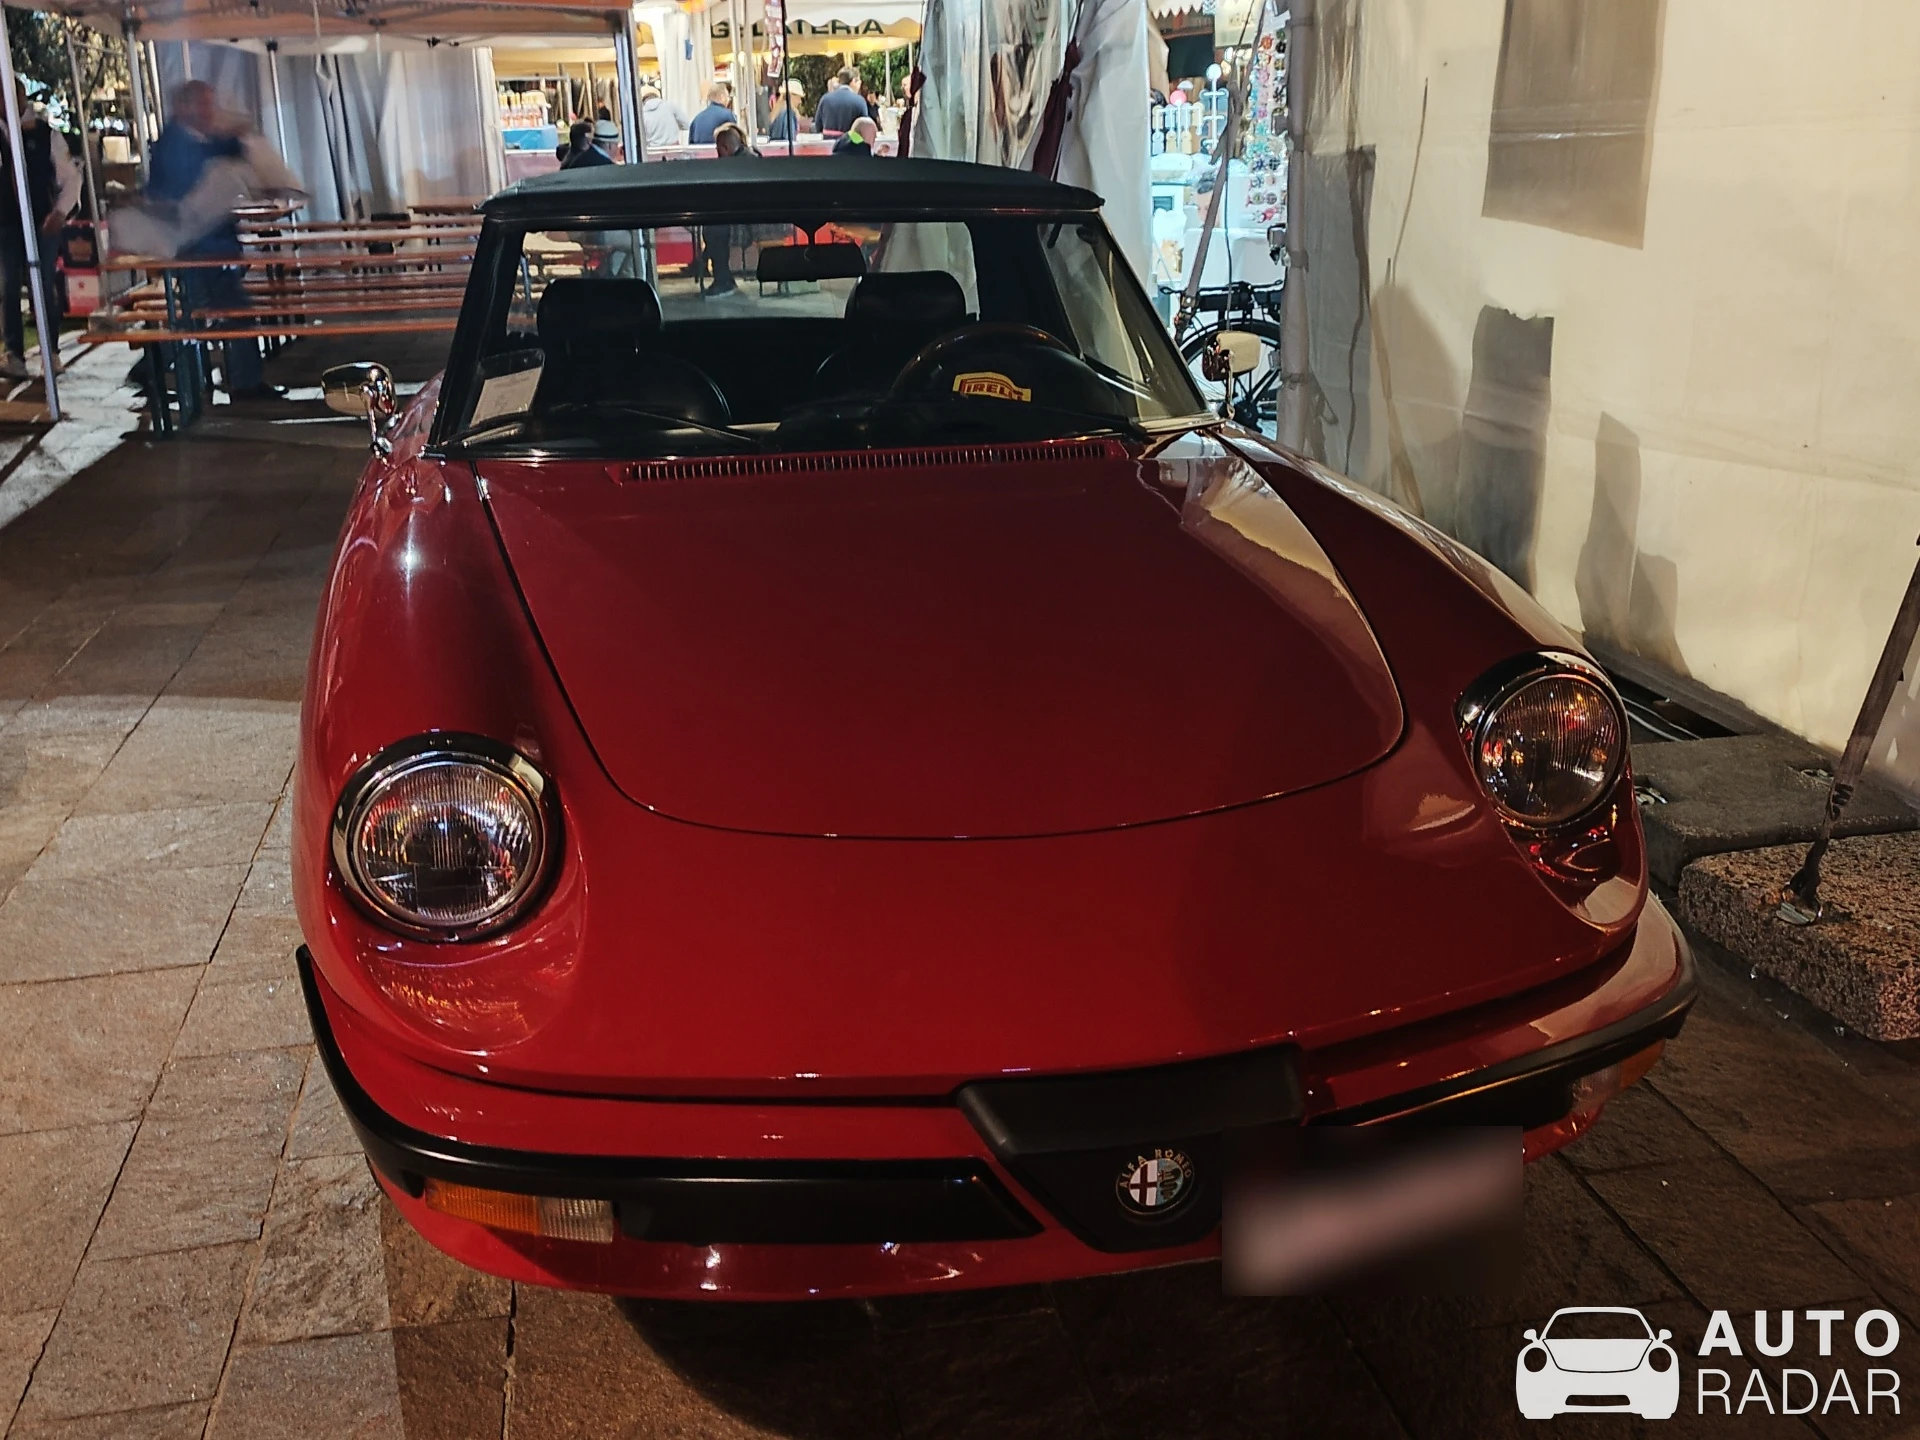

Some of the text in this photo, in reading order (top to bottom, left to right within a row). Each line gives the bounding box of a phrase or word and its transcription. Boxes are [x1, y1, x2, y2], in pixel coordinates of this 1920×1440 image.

[710, 18, 884, 38] GLTERIA
[1119, 1148, 1192, 1188] ALFA ROMEO
